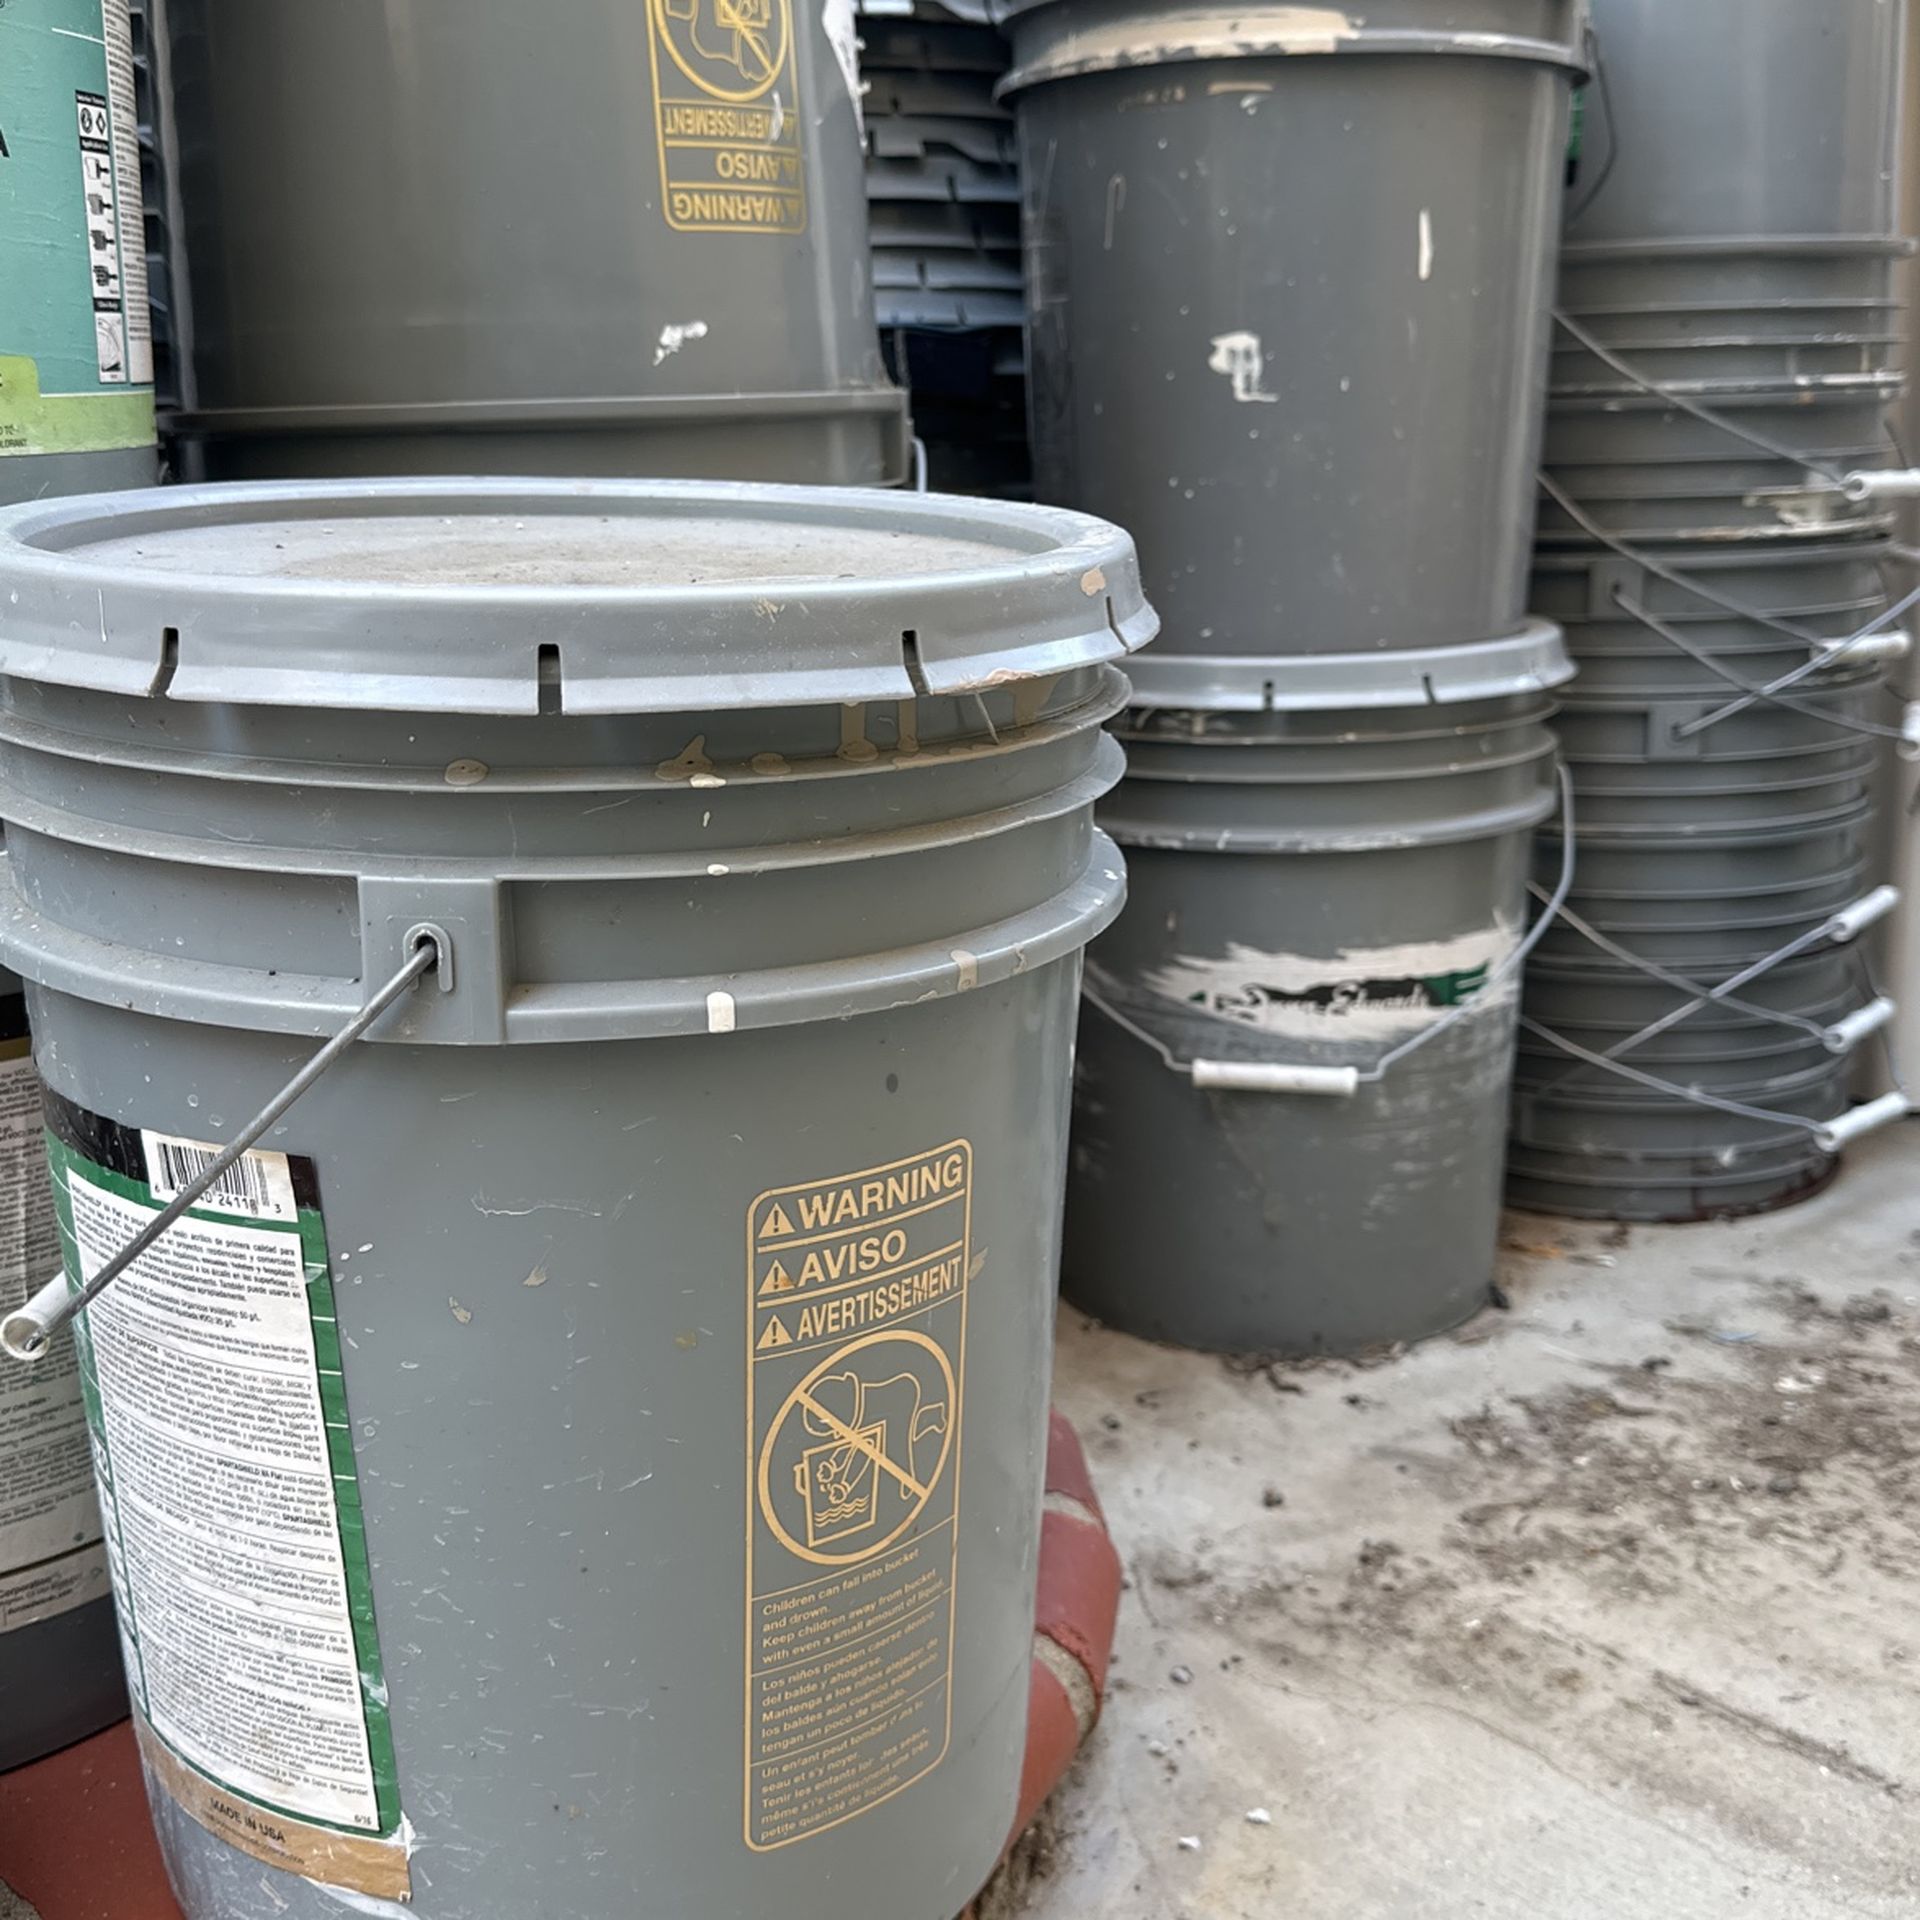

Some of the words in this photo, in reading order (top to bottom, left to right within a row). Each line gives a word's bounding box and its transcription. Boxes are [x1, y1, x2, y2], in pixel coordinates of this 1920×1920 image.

[716, 151, 780, 180] AVISO
[672, 191, 785, 223] WARNING
[274, 1203, 282, 1214] 3
[798, 1153, 963, 1230] WARNING
[797, 1229, 907, 1288] AVISO
[797, 1255, 962, 1341] AVERTISSEMENT
[763, 1593, 816, 1616] Children
[818, 1584, 840, 1600] can
[842, 1575, 860, 1591] fall
[862, 1567, 883, 1583] into
[885, 1548, 919, 1573] bucket
[763, 1632, 795, 1649] Keep
[798, 1615, 846, 1637] children
[849, 1601, 877, 1619] away
[879, 1588, 903, 1606] from
[904, 1568, 936, 1594] bucket
[763, 1616, 787, 1632] and
[789, 1605, 832, 1624] drown.
[762, 1648, 789, 1665] with
[792, 1639, 821, 1655] even
[834, 1621, 864, 1640] small
[865, 1602, 904, 1627] amount
[762, 1679, 785, 1692] Los
[788, 1666, 821, 1684] niños
[823, 1649, 865, 1673] pueden
[762, 1693, 782, 1707] del
[784, 1682, 818, 1700] balde
[762, 1696, 823, 1723] Mantenga
[834, 1685, 852, 1697] los
[762, 1726, 780, 1738] los
[784, 1712, 823, 1731] baldes
[762, 1734, 804, 1753] tengan
[807, 1726, 822, 1738] un
[824, 1714, 853, 1734] poco
[762, 1767, 779, 1779] Un
[823, 1741, 848, 1759] peut
[761, 1779, 791, 1793] seau
[793, 1772, 805, 1783] et
[762, 1793, 791, 1809] Tenir
[795, 1787, 811, 1799] les
